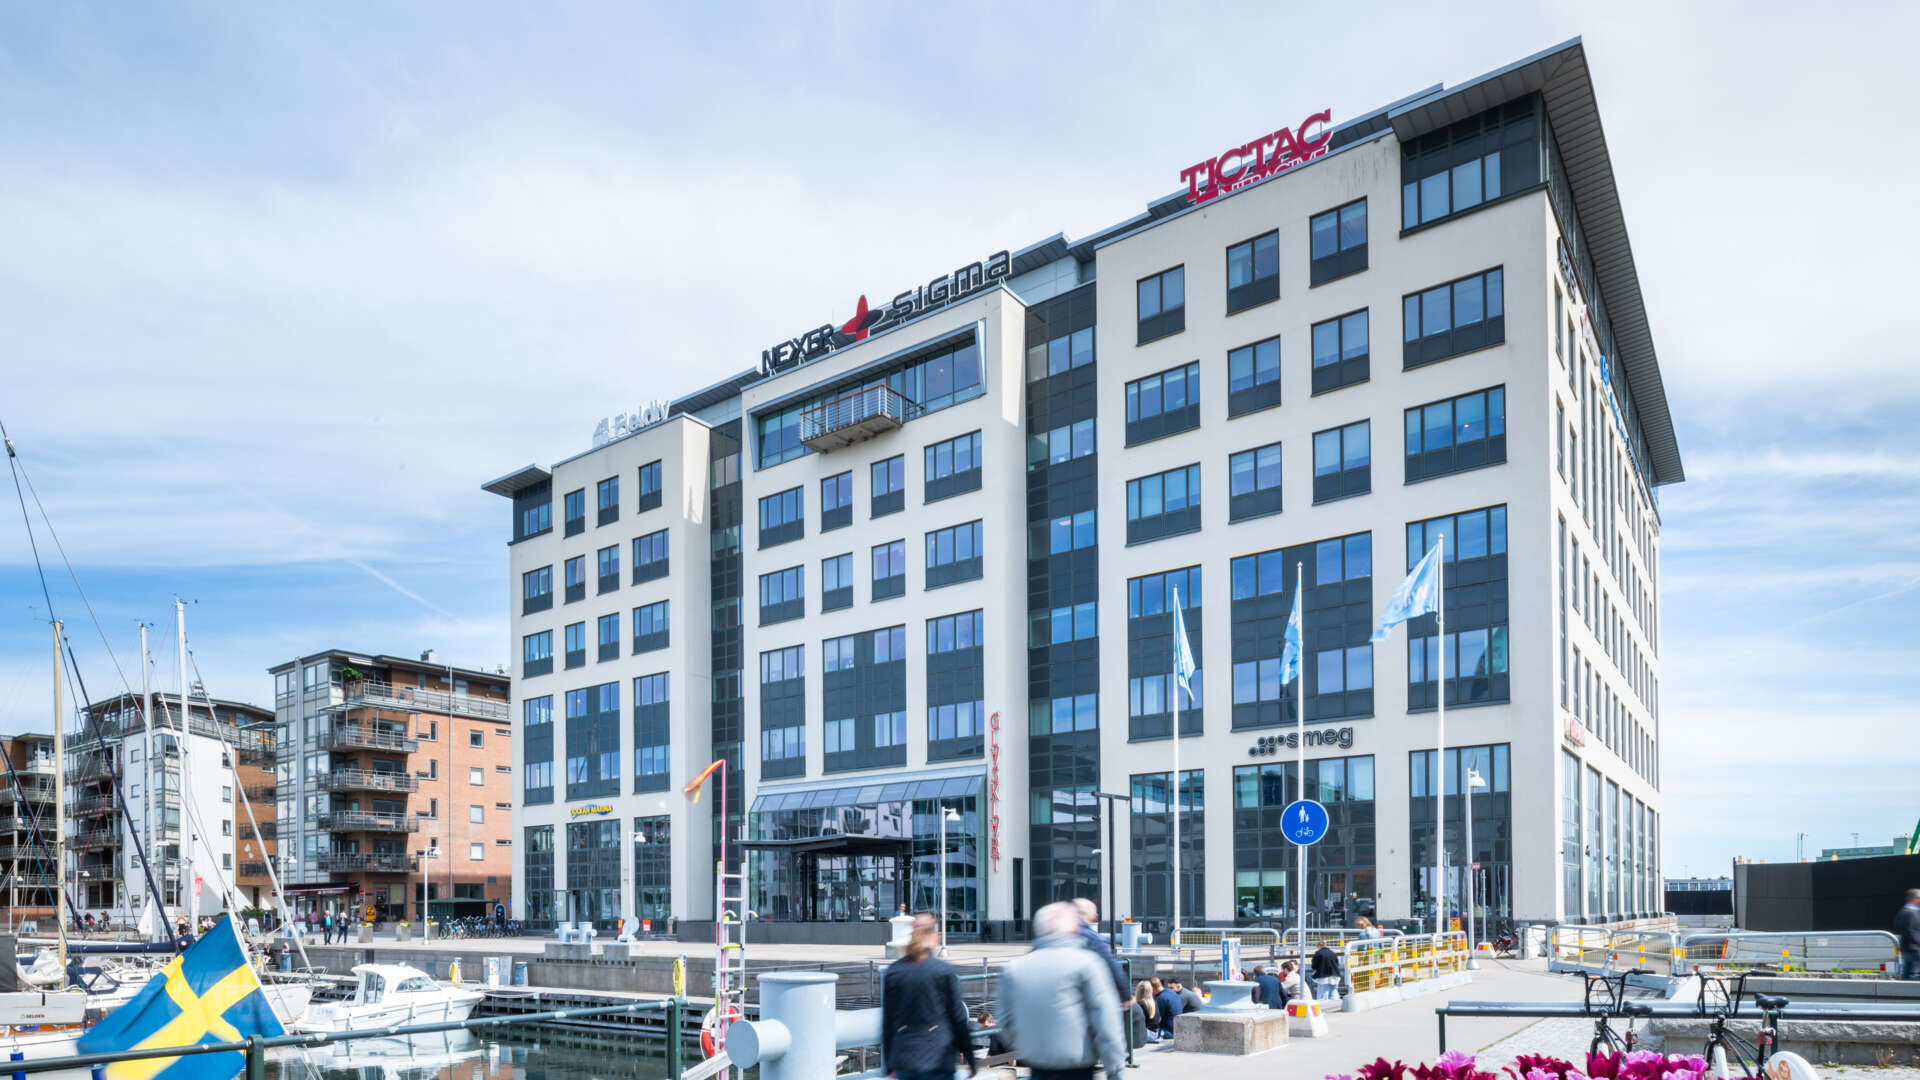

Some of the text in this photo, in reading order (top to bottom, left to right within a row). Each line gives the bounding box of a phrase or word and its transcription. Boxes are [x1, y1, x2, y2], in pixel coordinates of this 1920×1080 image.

[1180, 108, 1335, 201] TICTAC
[762, 323, 835, 374] NEXER
[1286, 727, 1353, 749] smeg
